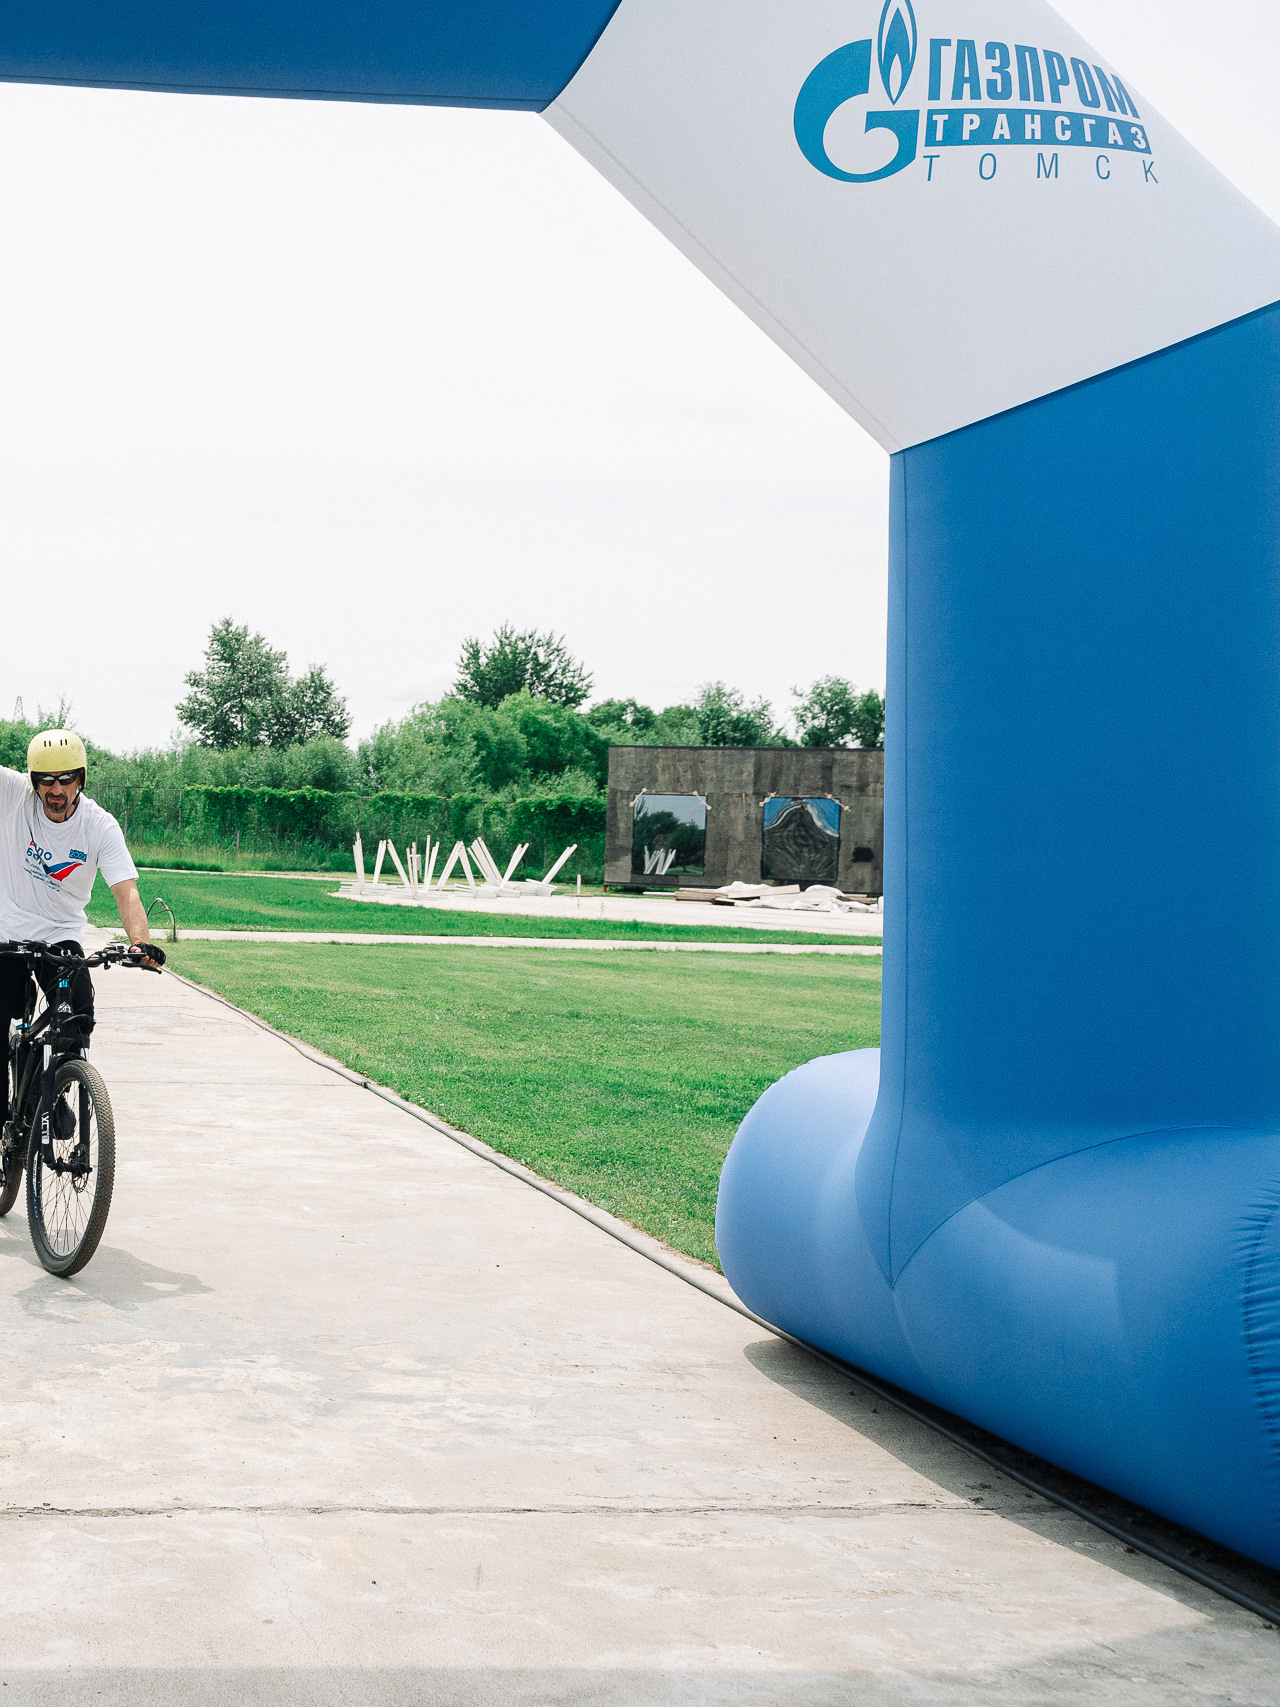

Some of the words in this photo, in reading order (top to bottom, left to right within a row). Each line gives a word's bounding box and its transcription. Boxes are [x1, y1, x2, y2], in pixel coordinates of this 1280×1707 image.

[927, 38, 1141, 119] ГАЗПРОМ
[932, 113, 1147, 150] ТРАНСГАЗ
[922, 152, 1160, 184] ТОМСК
